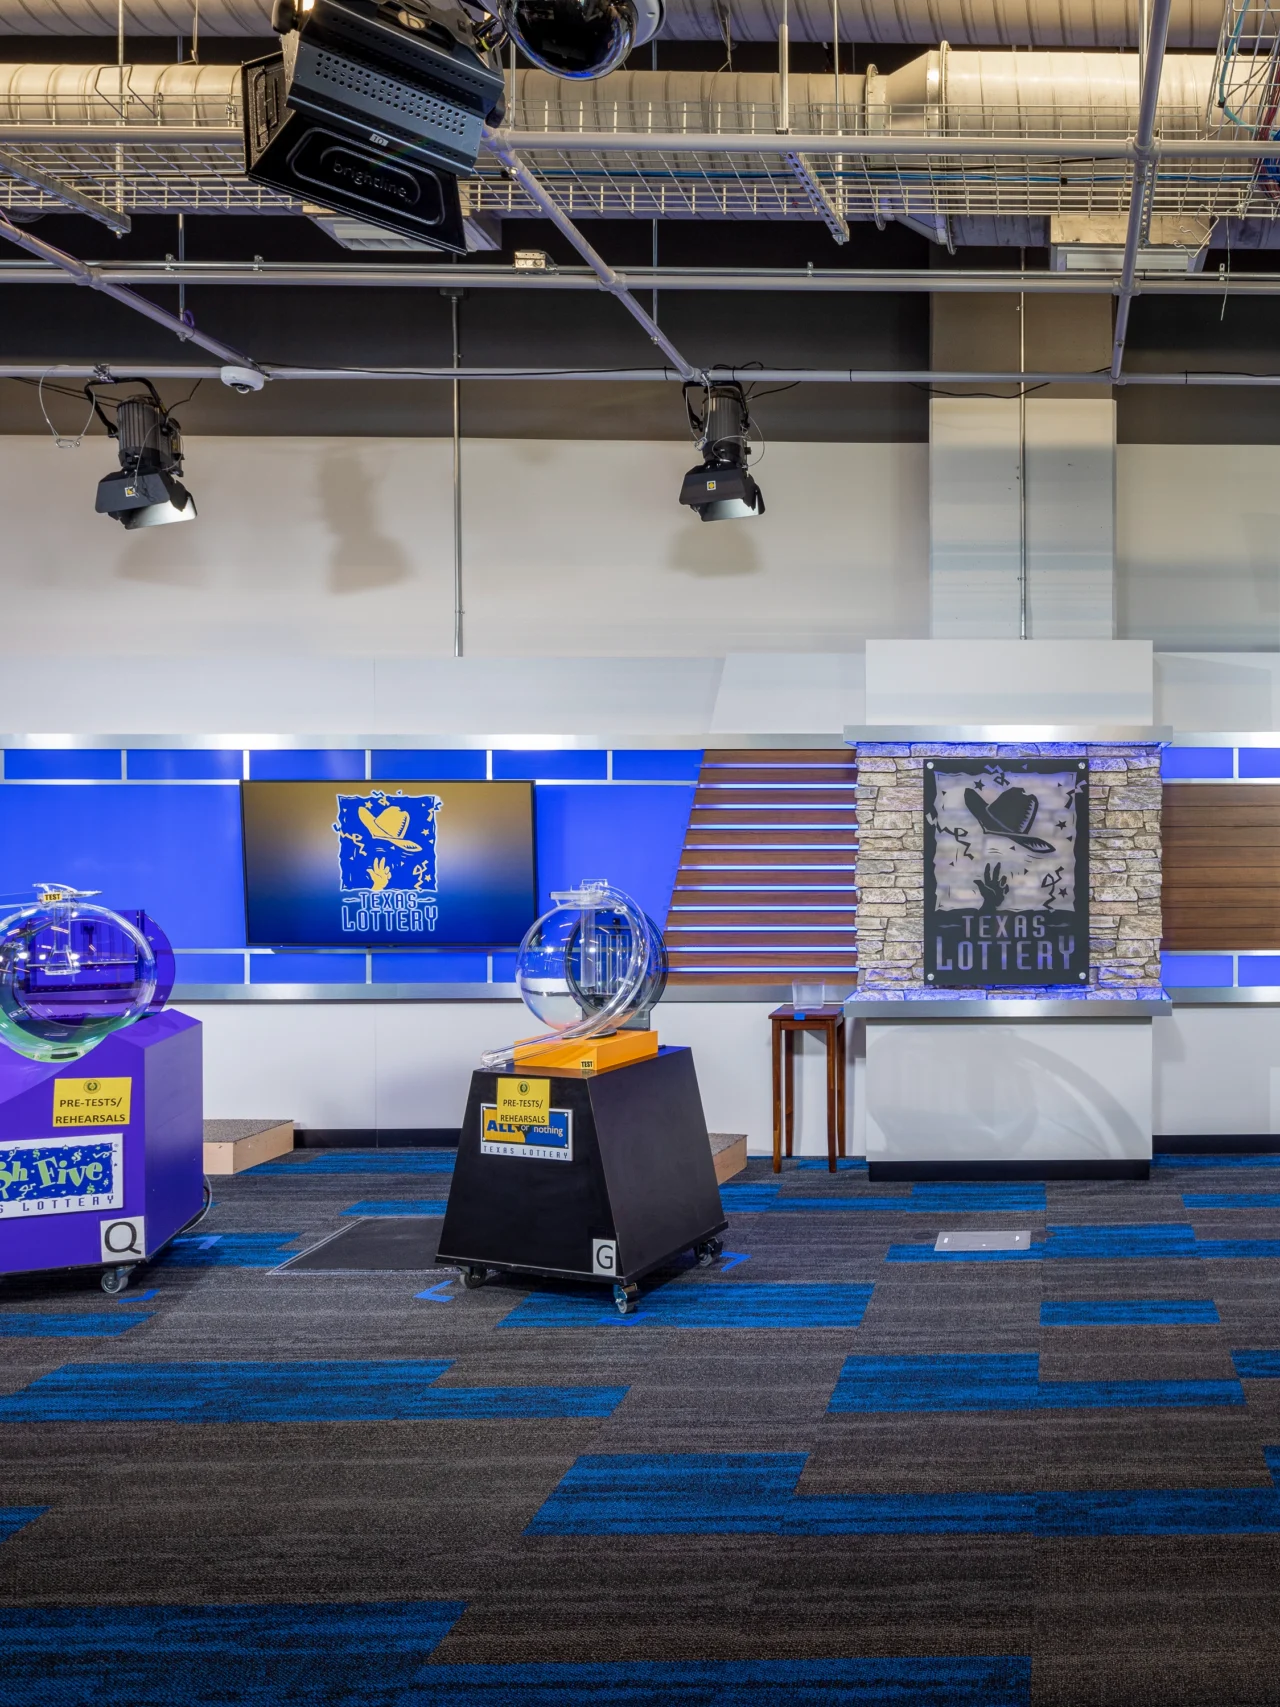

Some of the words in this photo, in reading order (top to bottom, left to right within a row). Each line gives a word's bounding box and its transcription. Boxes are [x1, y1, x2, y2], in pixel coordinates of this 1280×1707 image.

[333, 158, 407, 198] brightline
[44, 893, 61, 901] TEST
[359, 891, 418, 910] TEXAS
[341, 905, 439, 932] LOTTERY
[961, 914, 1046, 938] TEXAS
[936, 935, 1075, 971] LOTTERY
[580, 1060, 593, 1068] TEST
[59, 1097, 123, 1108] PRE-TESTS/
[502, 1098, 544, 1108] PRE-TESTS/
[55, 1113, 126, 1124] REHEARSALS
[500, 1113, 546, 1124] REHEARSALS
[486, 1119, 516, 1133] ALL
[533, 1125, 564, 1138] nothing
[483, 1145, 515, 1155] TEXAS
[522, 1148, 568, 1160] LOTTERY
[33, 1156, 103, 1189] Five
[22, 1195, 114, 1212] LOTTERY
[105, 1221, 142, 1255] Q
[596, 1244, 613, 1270] G
